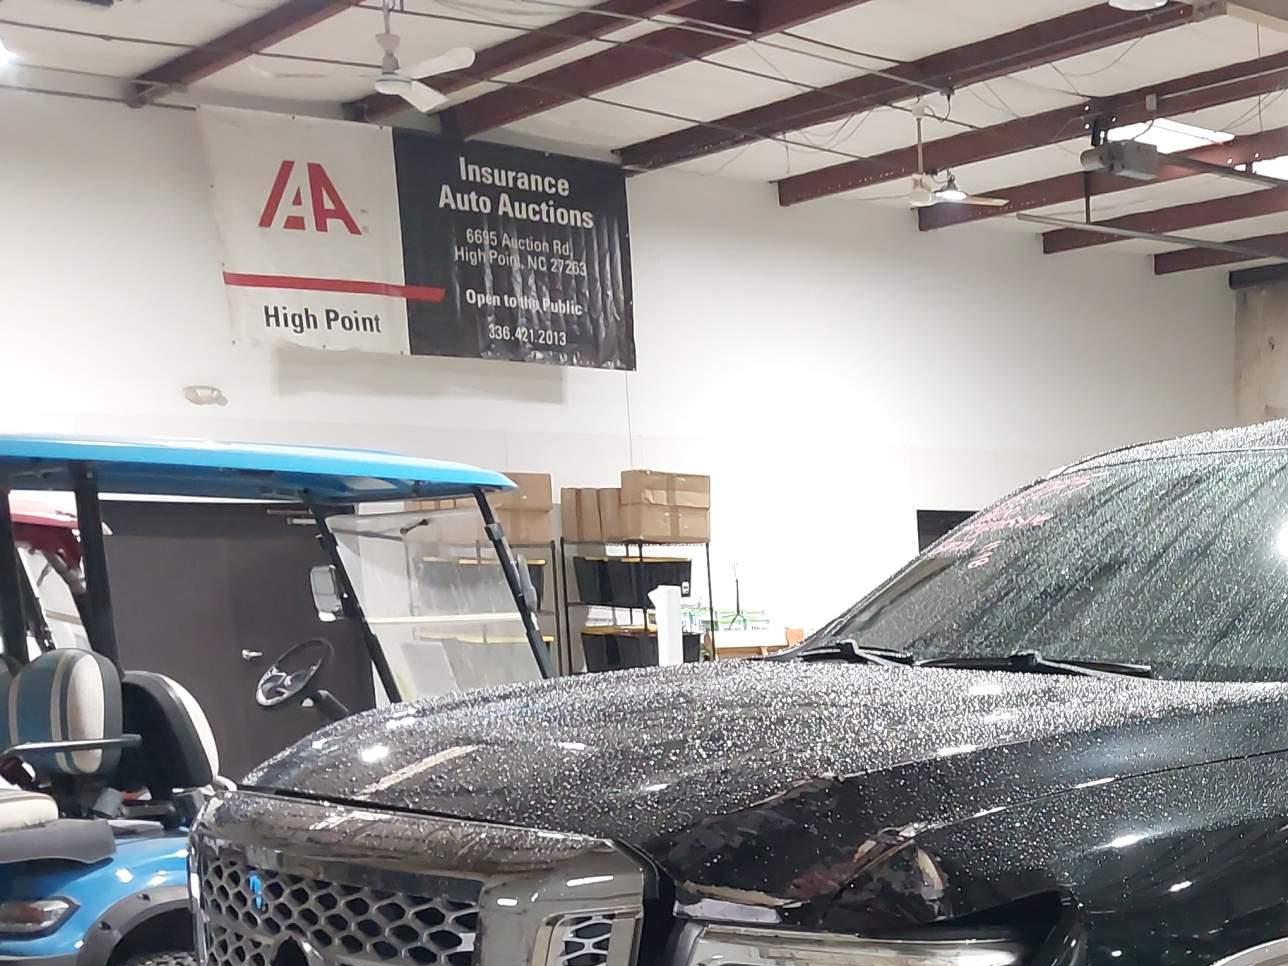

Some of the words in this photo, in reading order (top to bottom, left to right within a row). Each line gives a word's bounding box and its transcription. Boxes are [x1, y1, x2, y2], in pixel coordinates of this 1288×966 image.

[458, 156, 570, 196] Insurance
[438, 184, 492, 214] Auto
[498, 193, 594, 228] Auctions
[466, 228, 498, 246] 6695
[502, 233, 549, 253] Auction
[454, 246, 487, 265] High
[550, 259, 587, 276] 27263
[466, 289, 501, 309] Open
[504, 294, 517, 308] to
[542, 299, 583, 315] Public
[264, 305, 318, 334] High
[325, 309, 382, 333] Point
[488, 323, 567, 346] 336.421.2013
